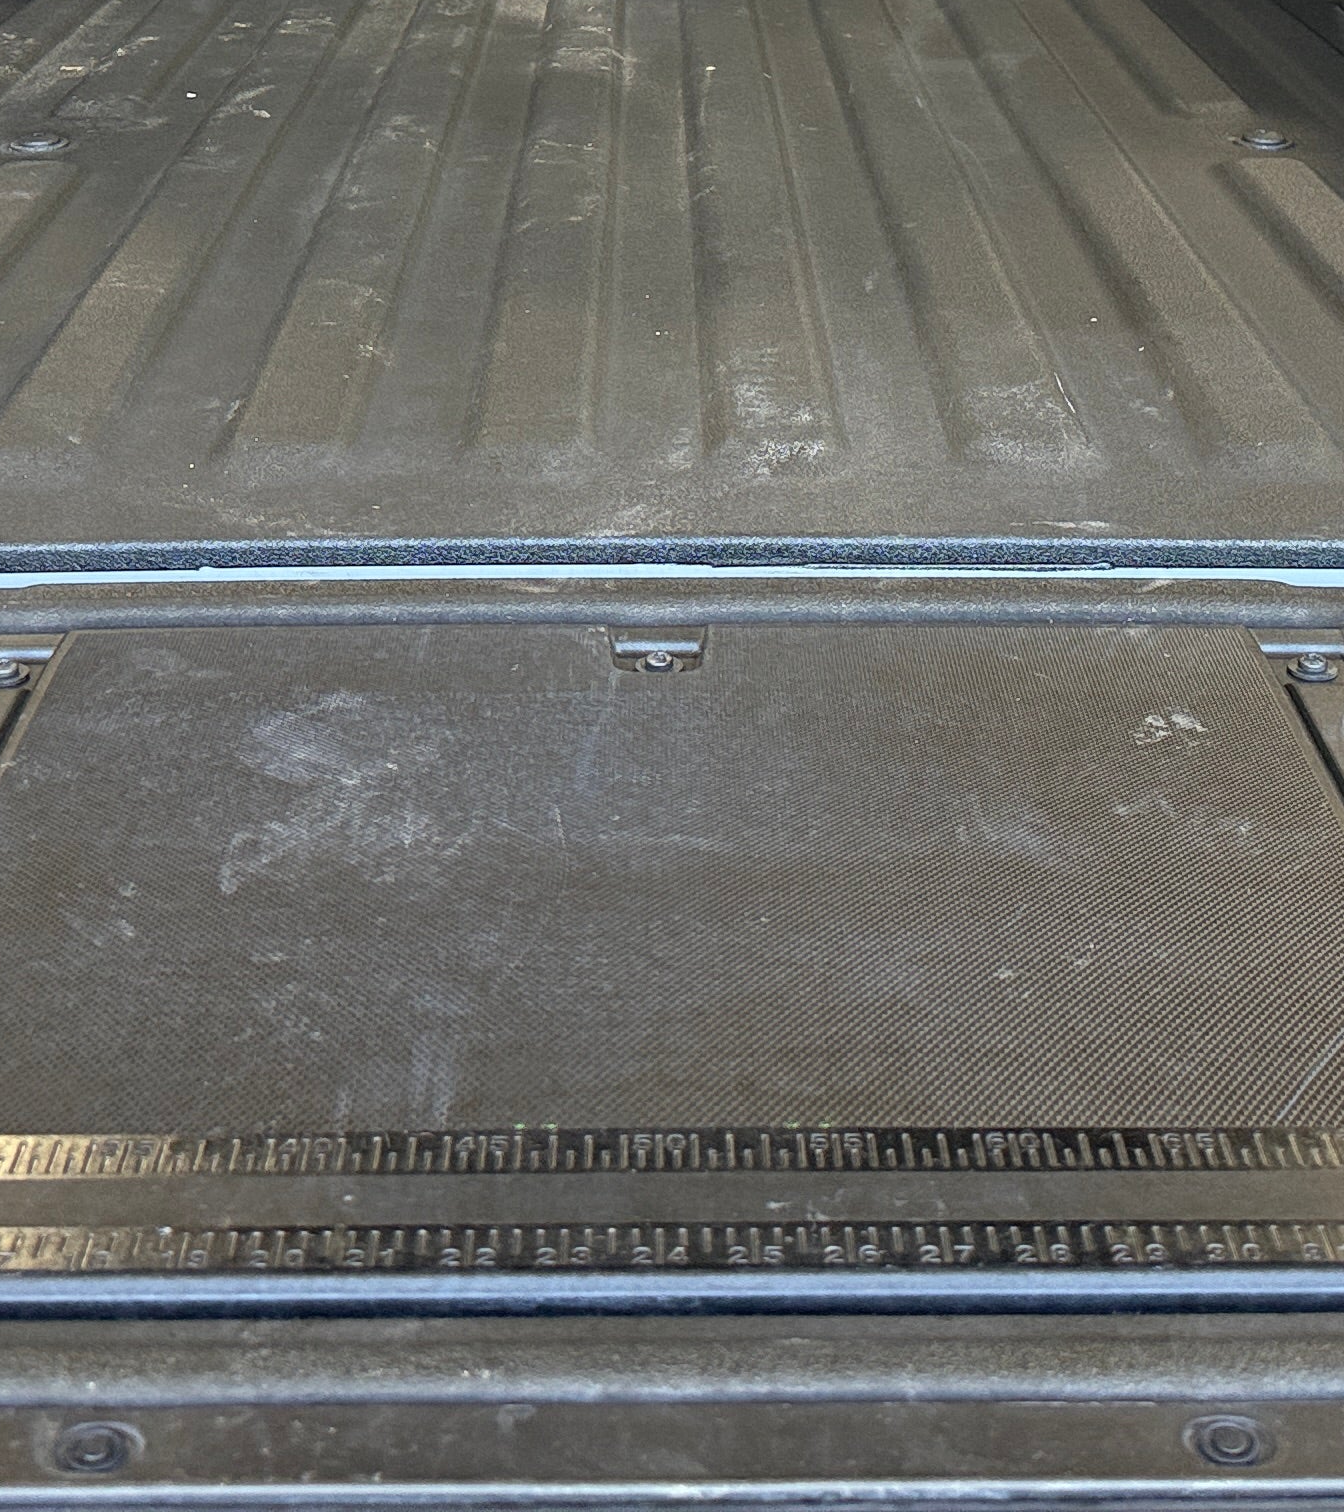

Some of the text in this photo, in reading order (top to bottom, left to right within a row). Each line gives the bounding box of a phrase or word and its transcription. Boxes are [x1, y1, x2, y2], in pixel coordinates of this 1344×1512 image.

[456, 1136, 509, 1152] 45
[632, 1134, 687, 1151] 50
[809, 1133, 864, 1149] 55
[986, 1133, 1040, 1149] 60
[1162, 1133, 1216, 1149] 65
[249, 1248, 306, 1268] 20
[344, 1248, 396, 1268] 21
[439, 1247, 498, 1267] 22
[535, 1246, 592, 1266] 23
[631, 1245, 689, 1265] 24
[727, 1245, 785, 1264] 25
[823, 1244, 881, 1264] 26
[919, 1244, 976, 1263] 27
[1014, 1243, 1073, 1263] 28
